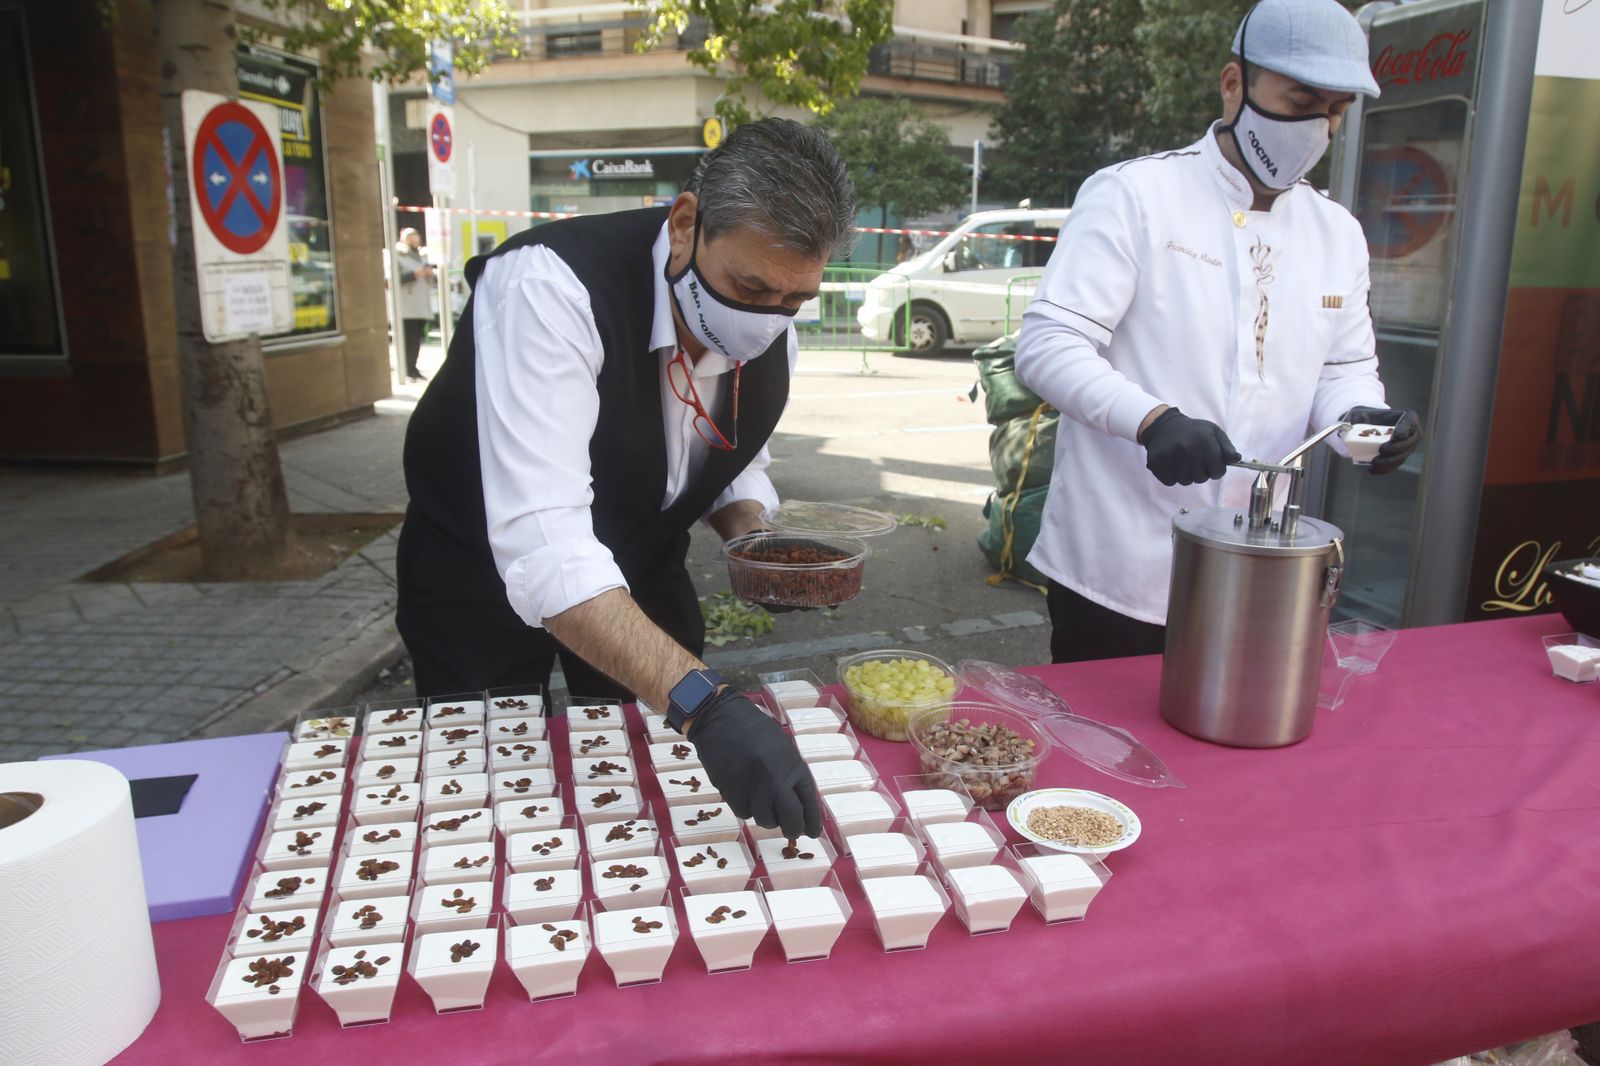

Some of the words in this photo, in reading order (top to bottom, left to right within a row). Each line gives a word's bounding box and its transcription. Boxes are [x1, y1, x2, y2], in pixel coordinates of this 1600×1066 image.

[592, 159, 654, 175] CaixaBank
[1247, 129, 1279, 178] COCINA
[688, 280, 702, 309] BAR
